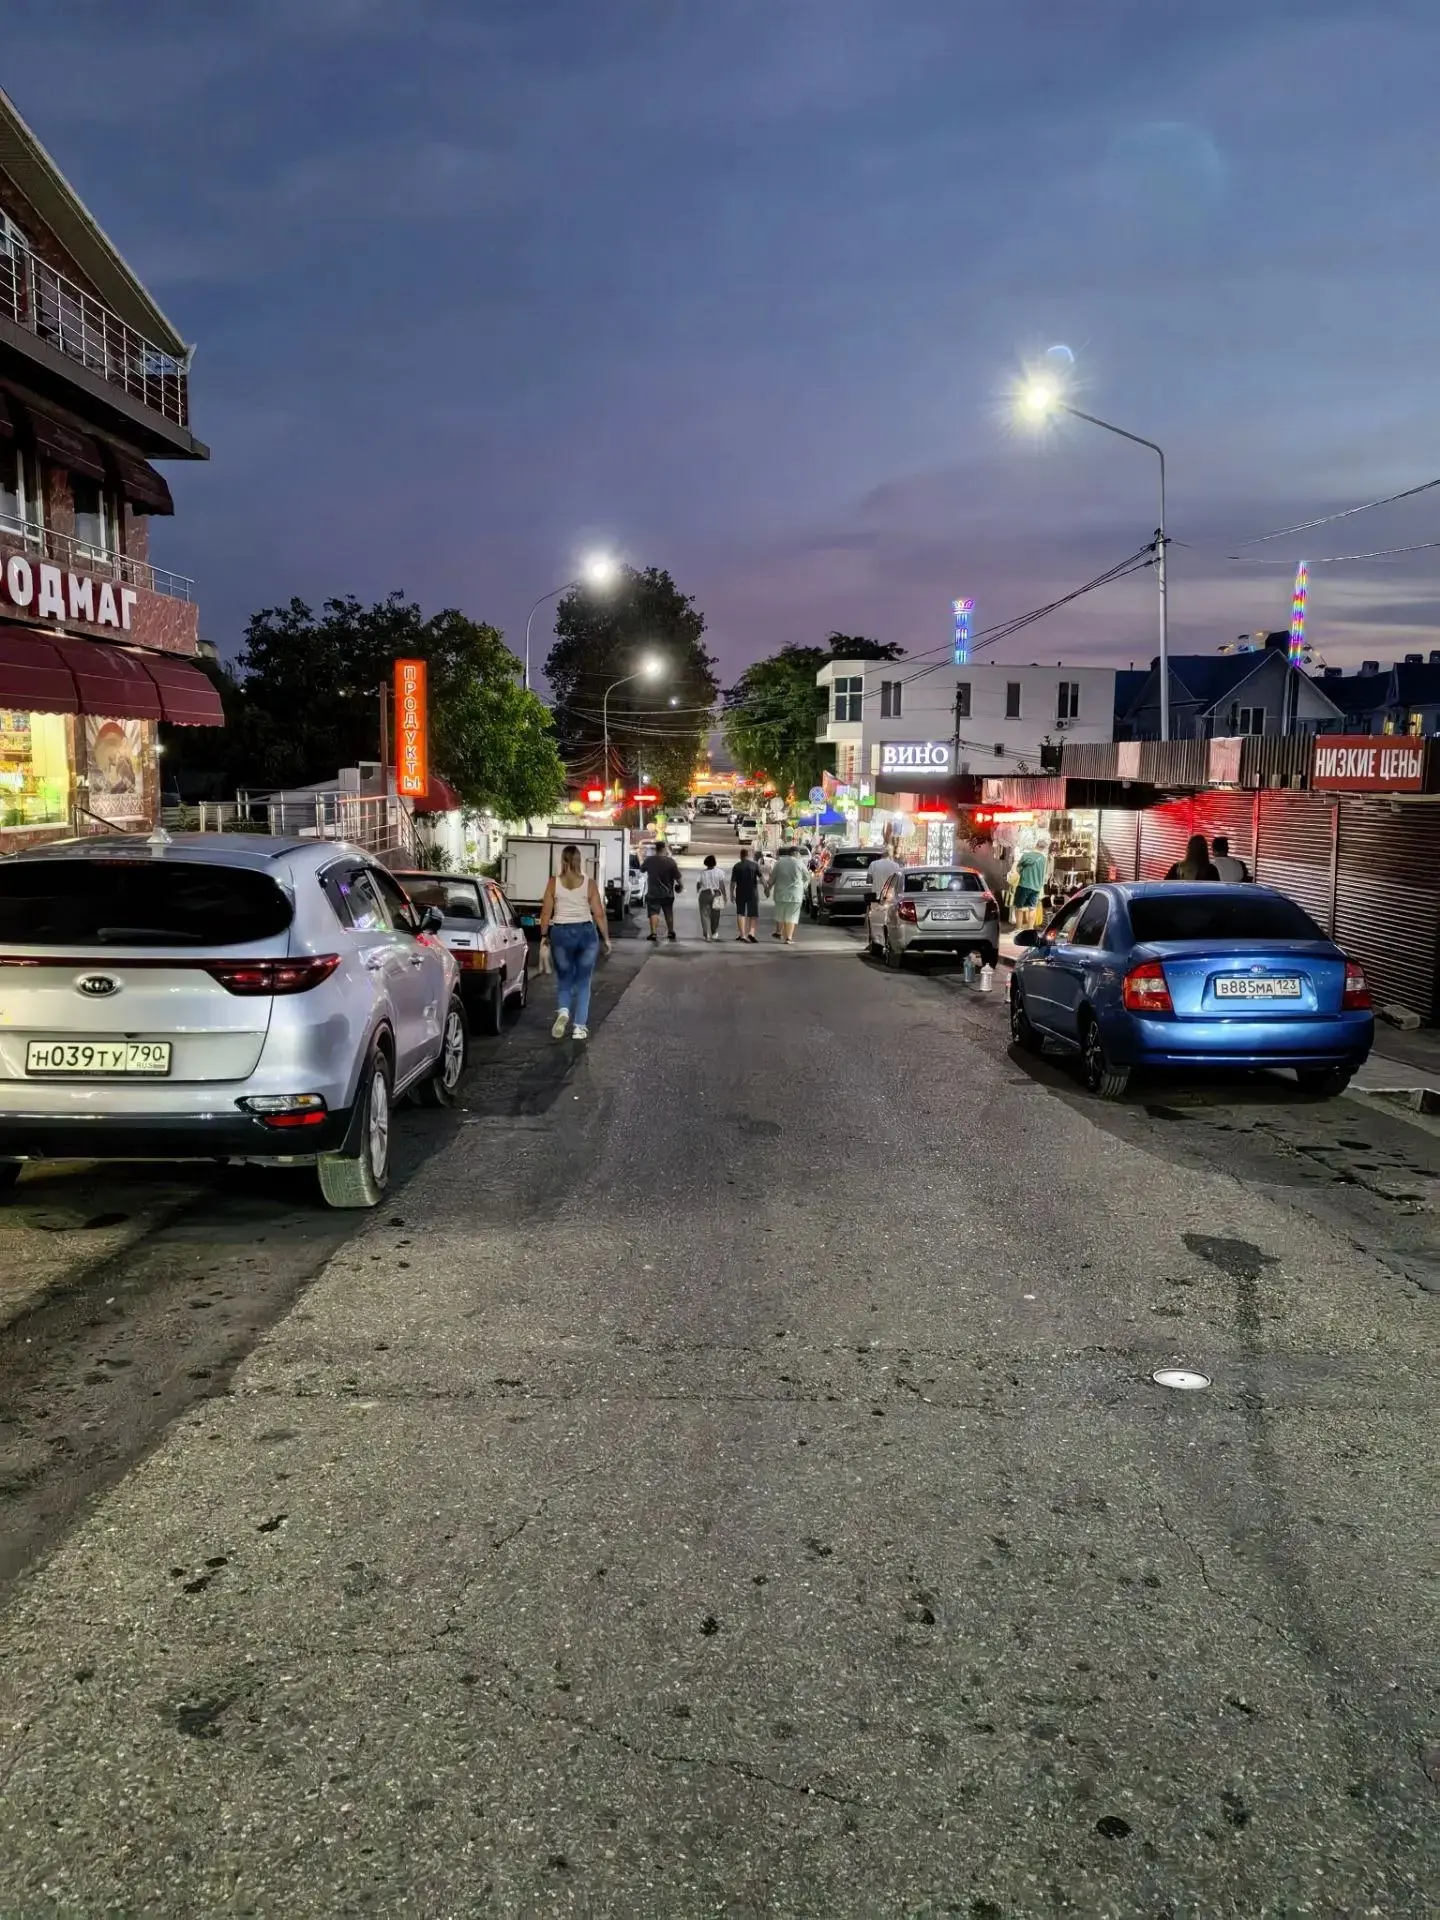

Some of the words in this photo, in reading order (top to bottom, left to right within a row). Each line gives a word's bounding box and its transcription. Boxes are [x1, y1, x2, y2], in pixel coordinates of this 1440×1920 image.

[0, 556, 137, 629] ОДМАГ
[404, 666, 420, 789] ПРОДУКТЫ
[883, 747, 948, 764] ВИНО
[1315, 749, 1377, 777] НИЗКИЕ
[1380, 750, 1422, 780] ЦЕНЫ
[1221, 981, 1274, 993] В885МА
[1277, 980, 1296, 989] 123
[36, 1046, 123, 1067] Н039ТУ
[129, 1045, 163, 1061] 790
